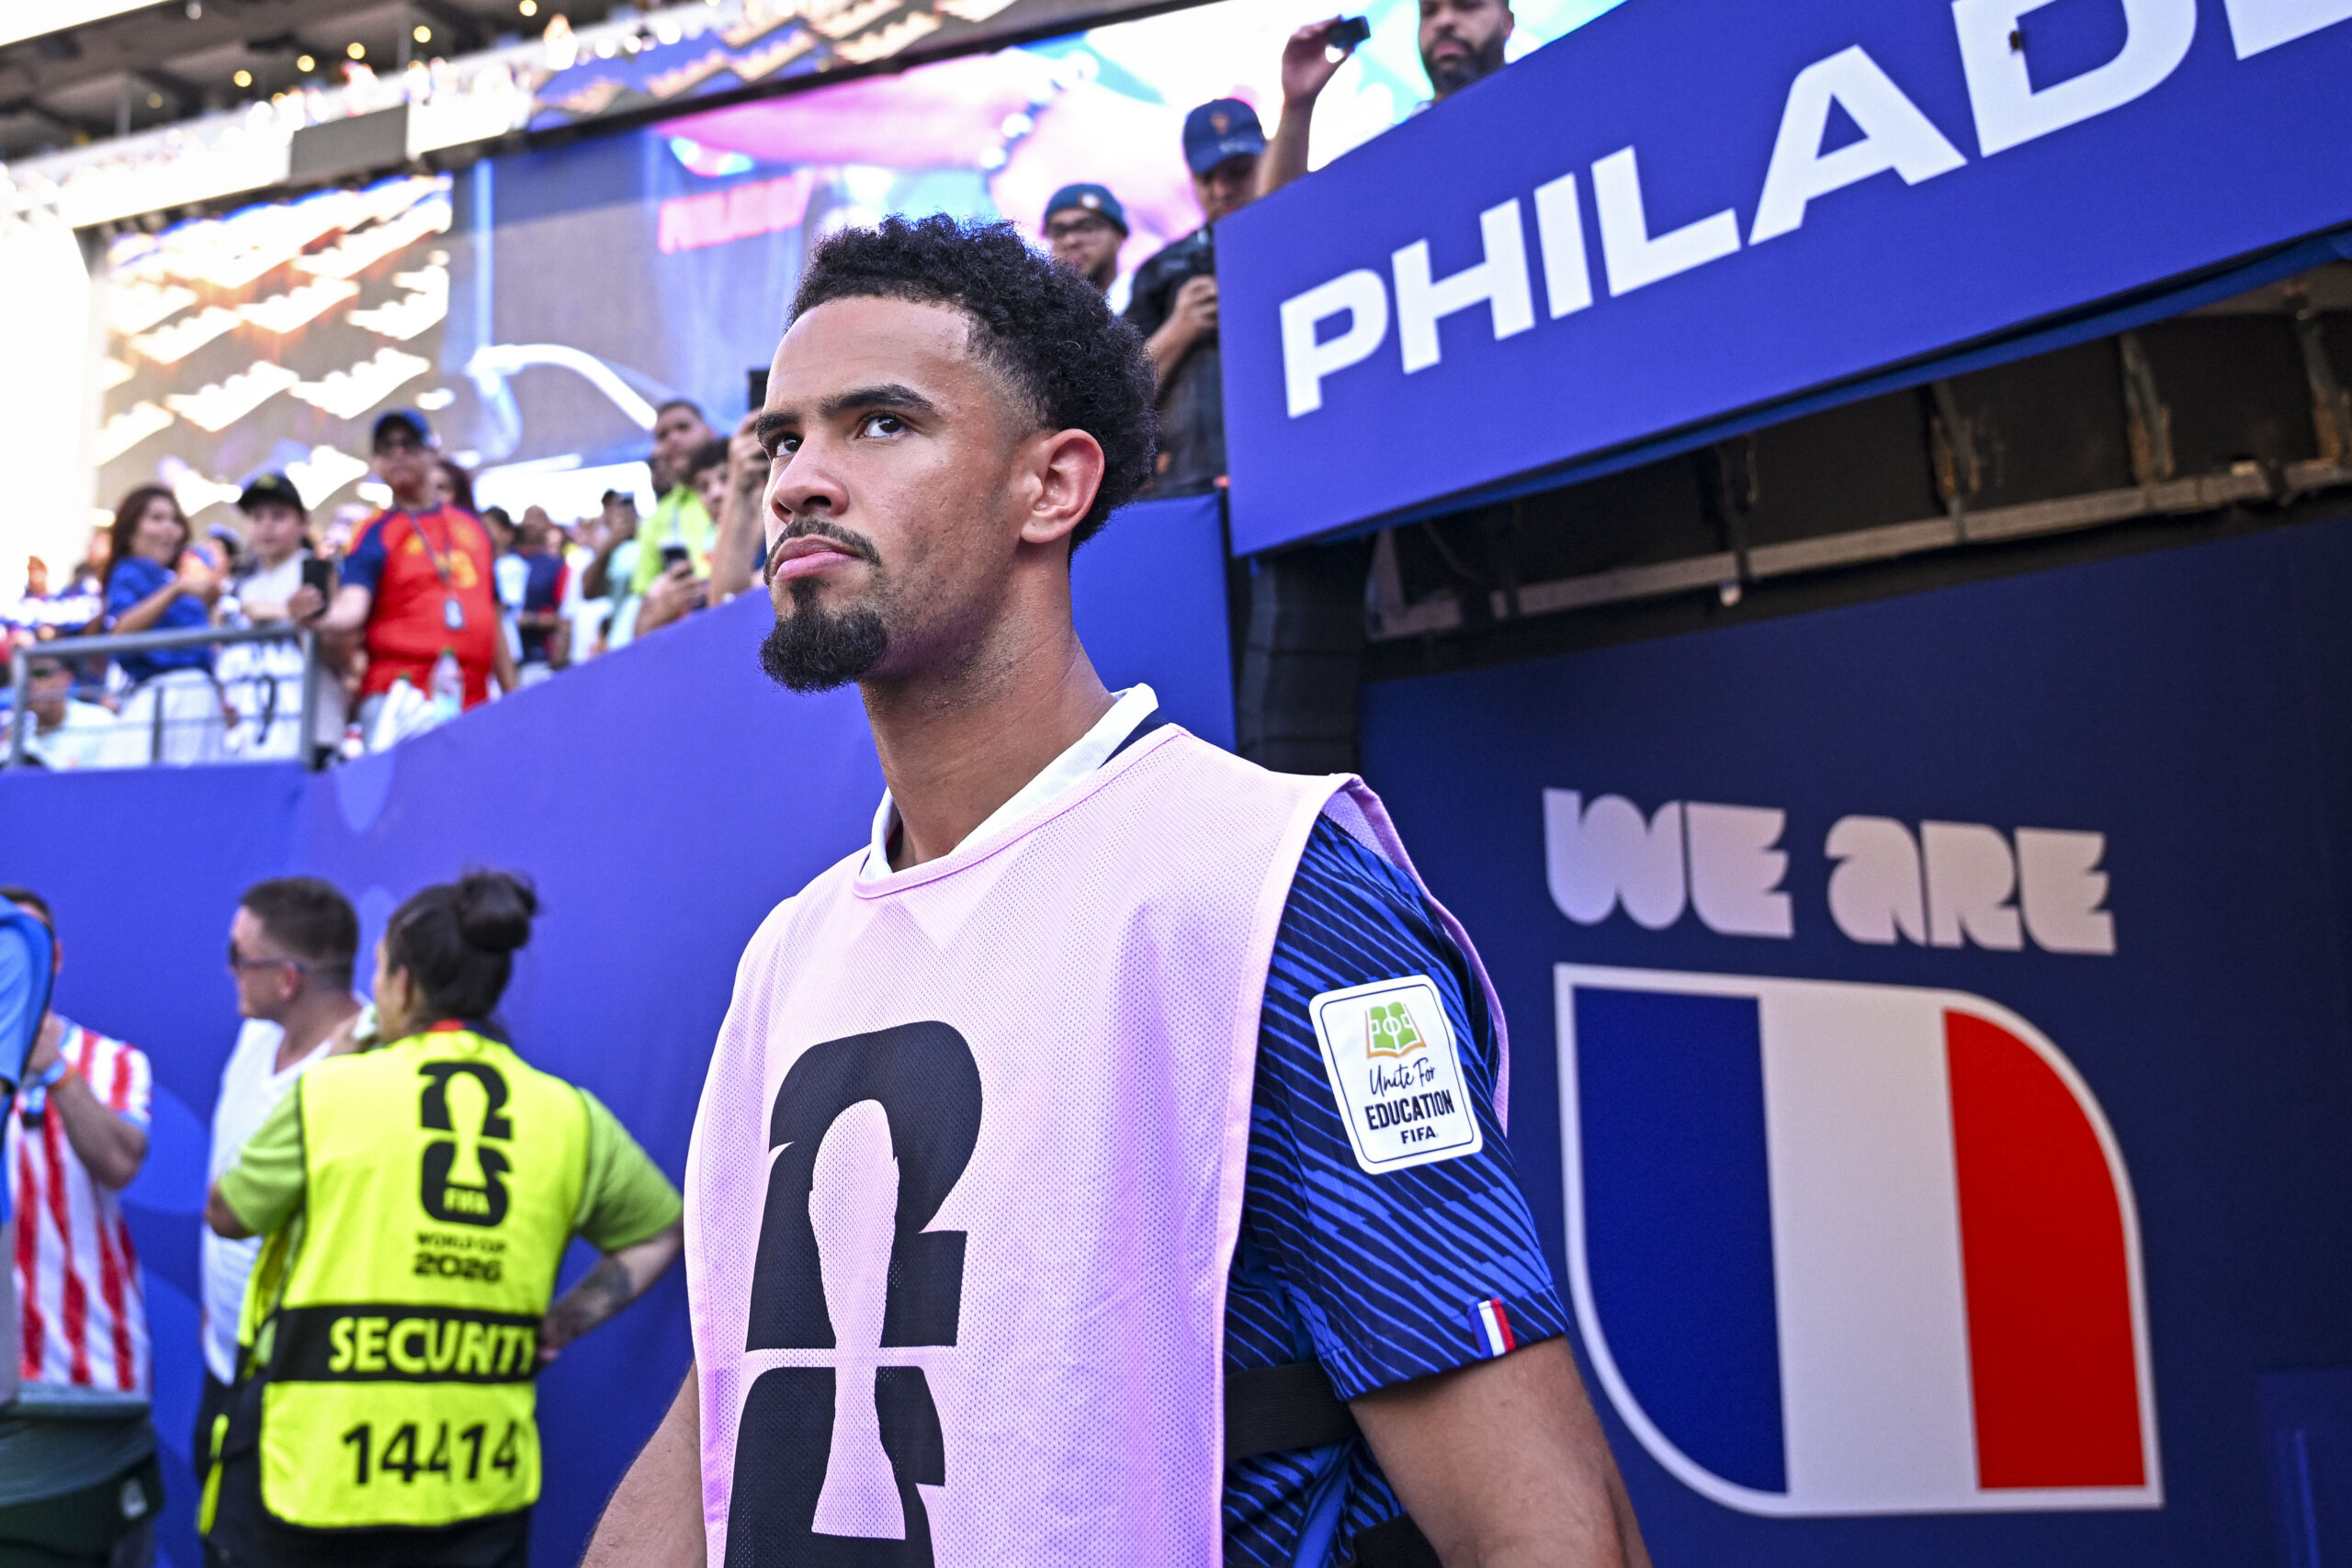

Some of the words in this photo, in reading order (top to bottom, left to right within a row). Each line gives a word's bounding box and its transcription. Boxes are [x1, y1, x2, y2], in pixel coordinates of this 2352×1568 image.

[1544, 787, 1793, 939] WE
[1370, 1064, 1414, 1097] Unite
[1413, 1057, 1436, 1087] For
[1364, 1089, 1455, 1130] EDUCATION
[1400, 1125, 1436, 1144] FIFA
[443, 1188, 492, 1215] FIFA
[413, 1252, 503, 1283] 2026
